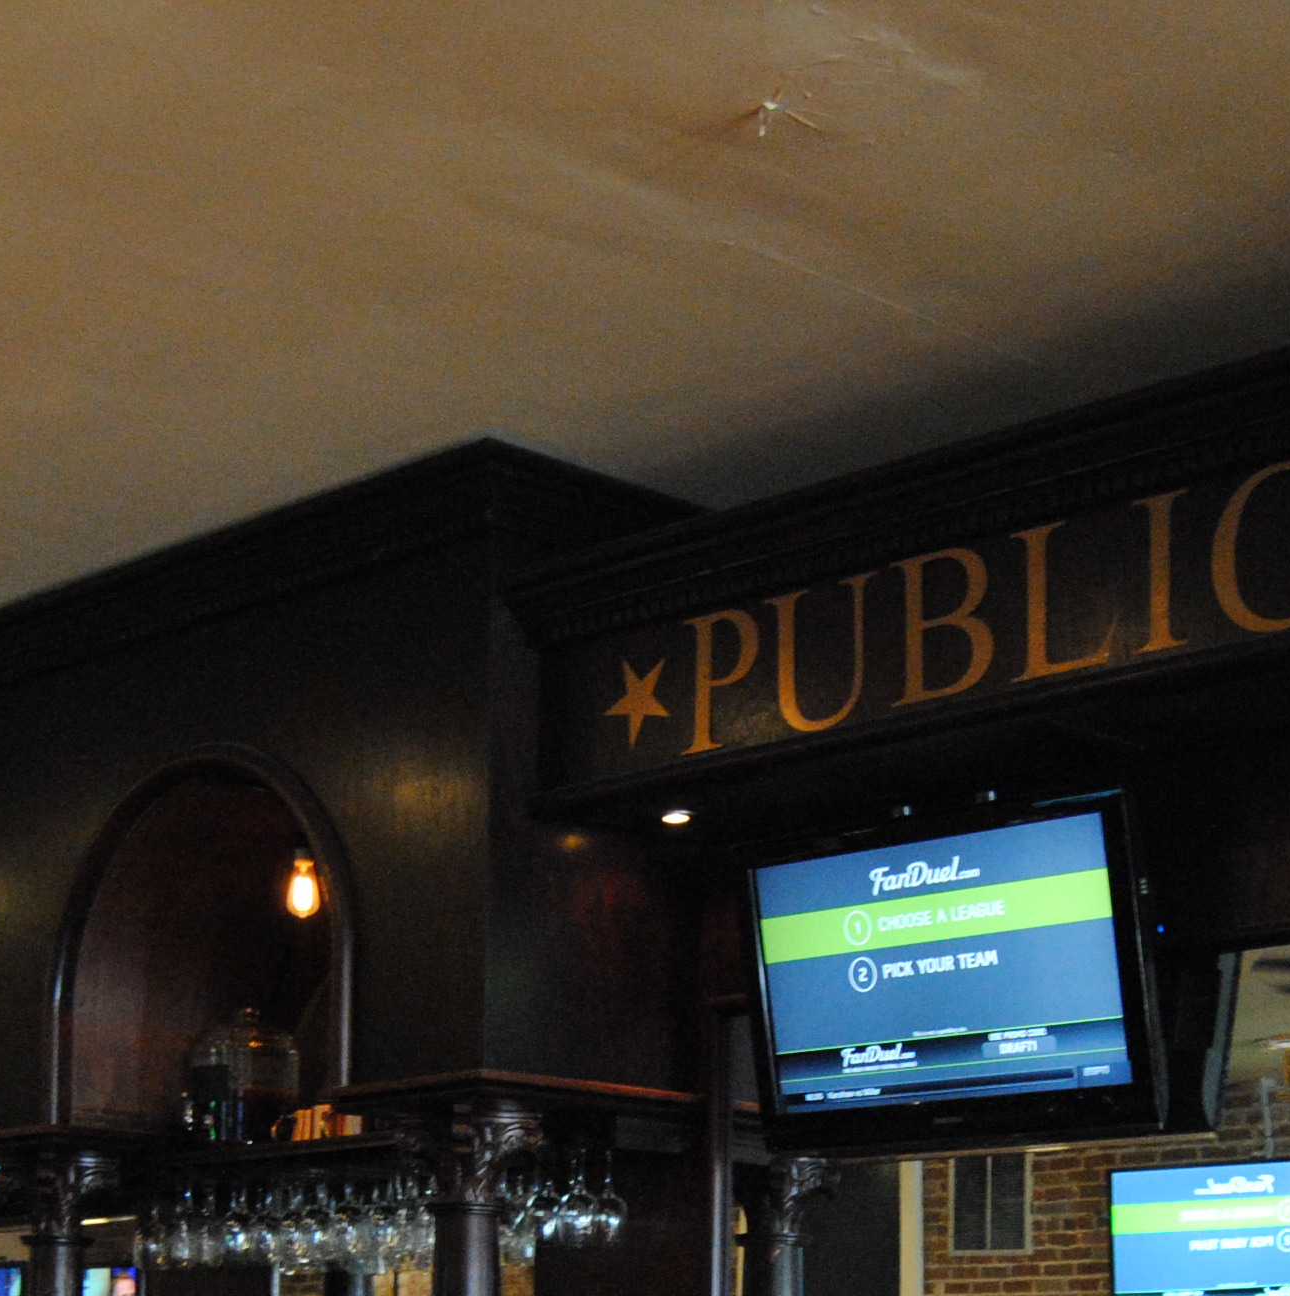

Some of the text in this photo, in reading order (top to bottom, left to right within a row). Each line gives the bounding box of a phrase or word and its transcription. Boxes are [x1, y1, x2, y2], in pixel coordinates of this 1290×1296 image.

[869, 855, 981, 897] FanDuel.com
[877, 910, 933, 932] CHOOSE
[937, 909, 947, 923] A
[950, 899, 1006, 922] LEAGUE
[881, 959, 915, 979] PICK
[917, 954, 955, 975] YOUR
[956, 949, 999, 970] TEAM
